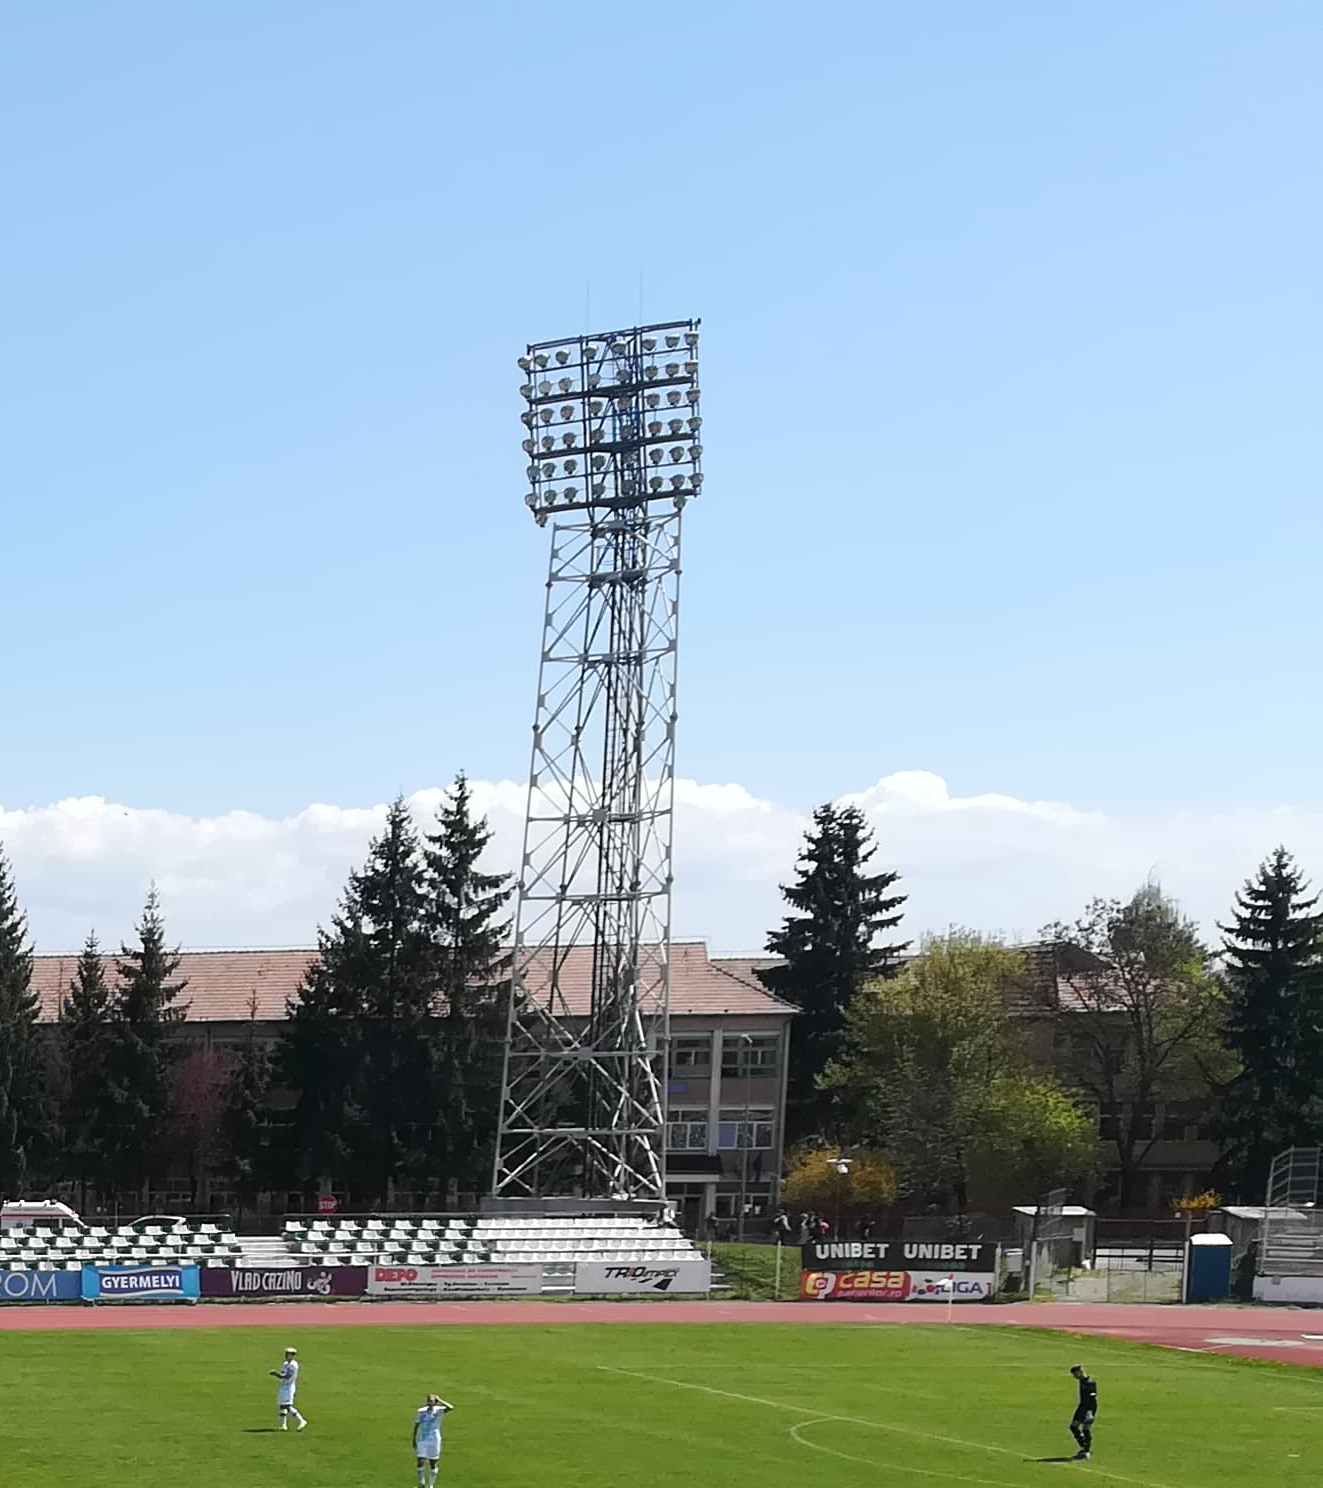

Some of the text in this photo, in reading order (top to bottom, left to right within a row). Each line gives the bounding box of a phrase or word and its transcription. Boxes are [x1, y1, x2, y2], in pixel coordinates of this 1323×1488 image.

[816, 1243, 982, 1260] UNIBET UNIBET
[101, 1274, 179, 1290] GYERMELYI
[231, 1270, 302, 1292] VLAD CAZINO
